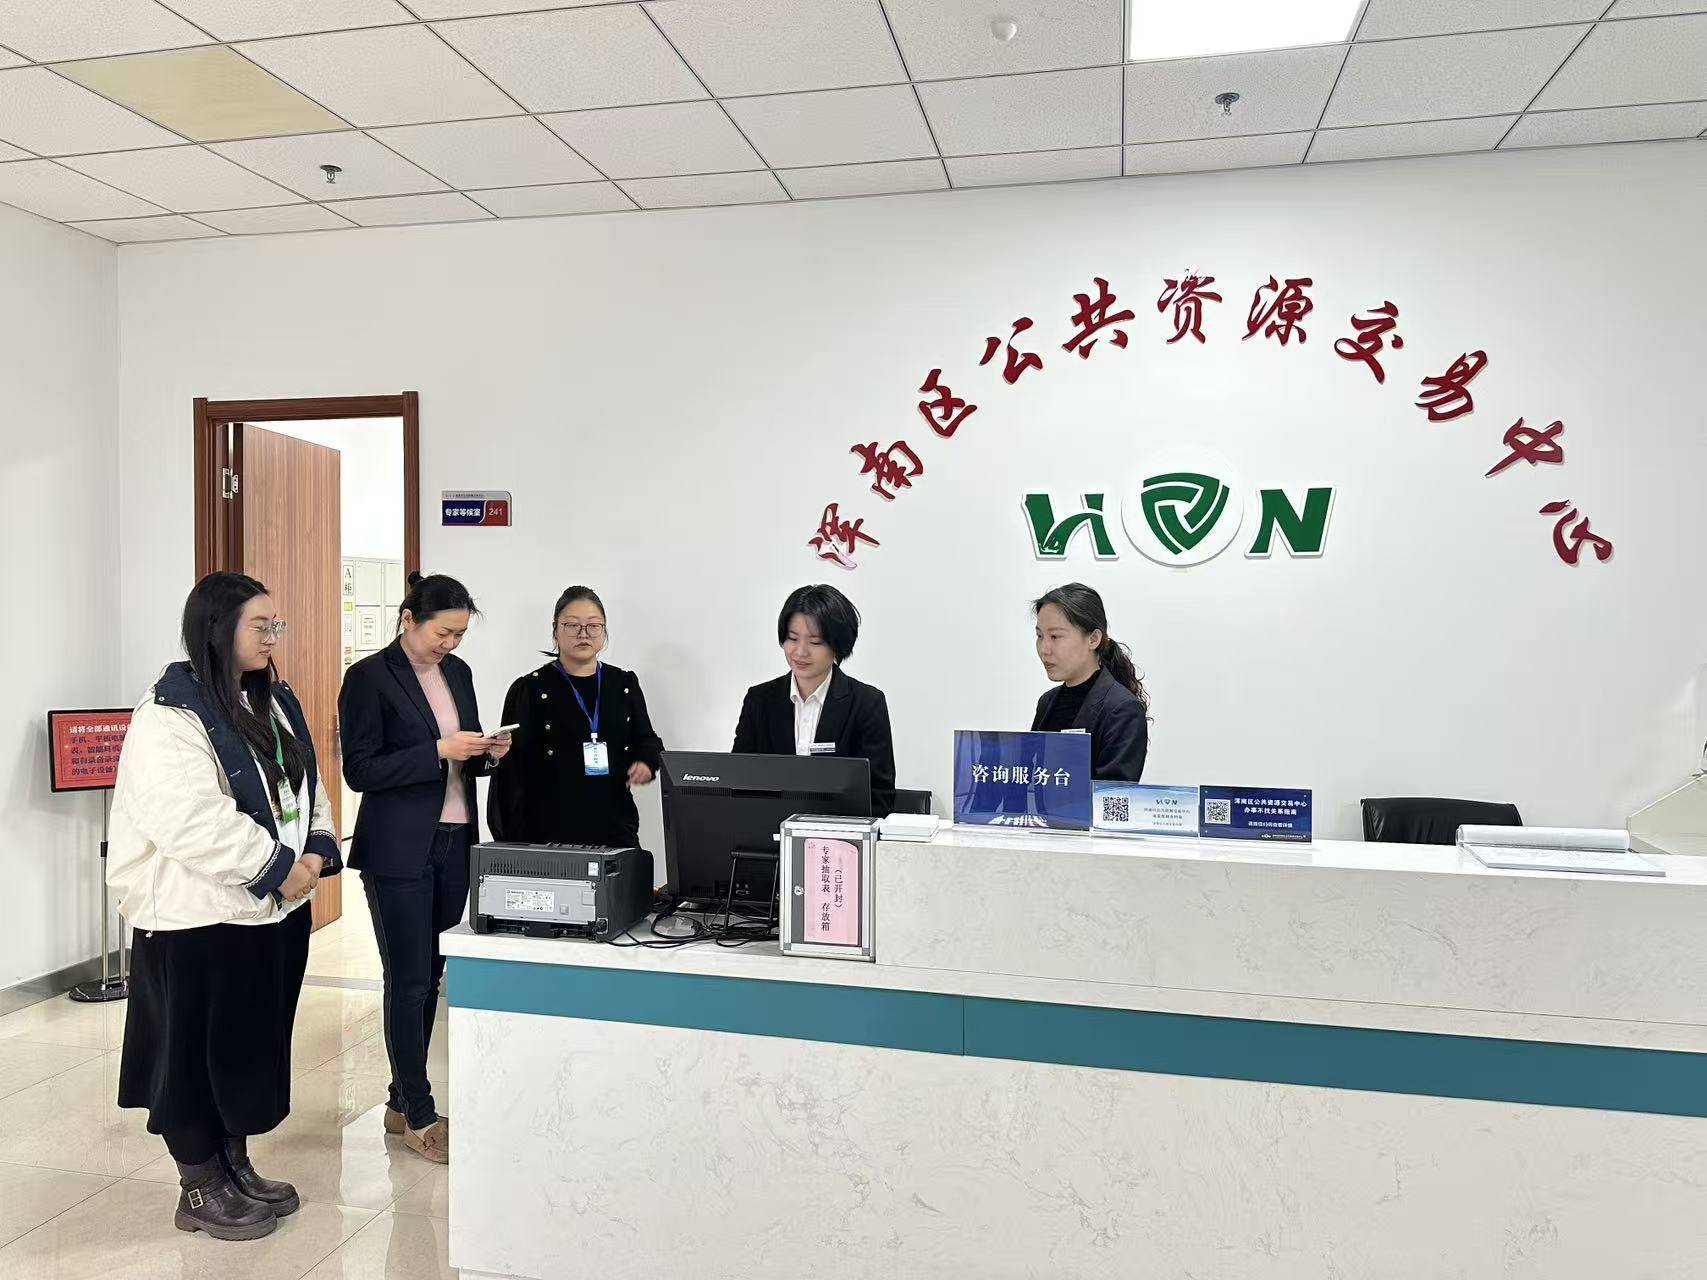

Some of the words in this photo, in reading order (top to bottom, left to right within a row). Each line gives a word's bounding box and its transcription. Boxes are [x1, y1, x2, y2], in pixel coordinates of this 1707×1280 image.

[488, 507, 503, 516] 241
[682, 773, 720, 782] lenovo
[972, 764, 1071, 787] 咨询服务台
[1234, 797, 1308, 808] 浑南区公共资源交易中心
[821, 845, 831, 893] 专家抽取表
[821, 902, 830, 932] 存放箱
